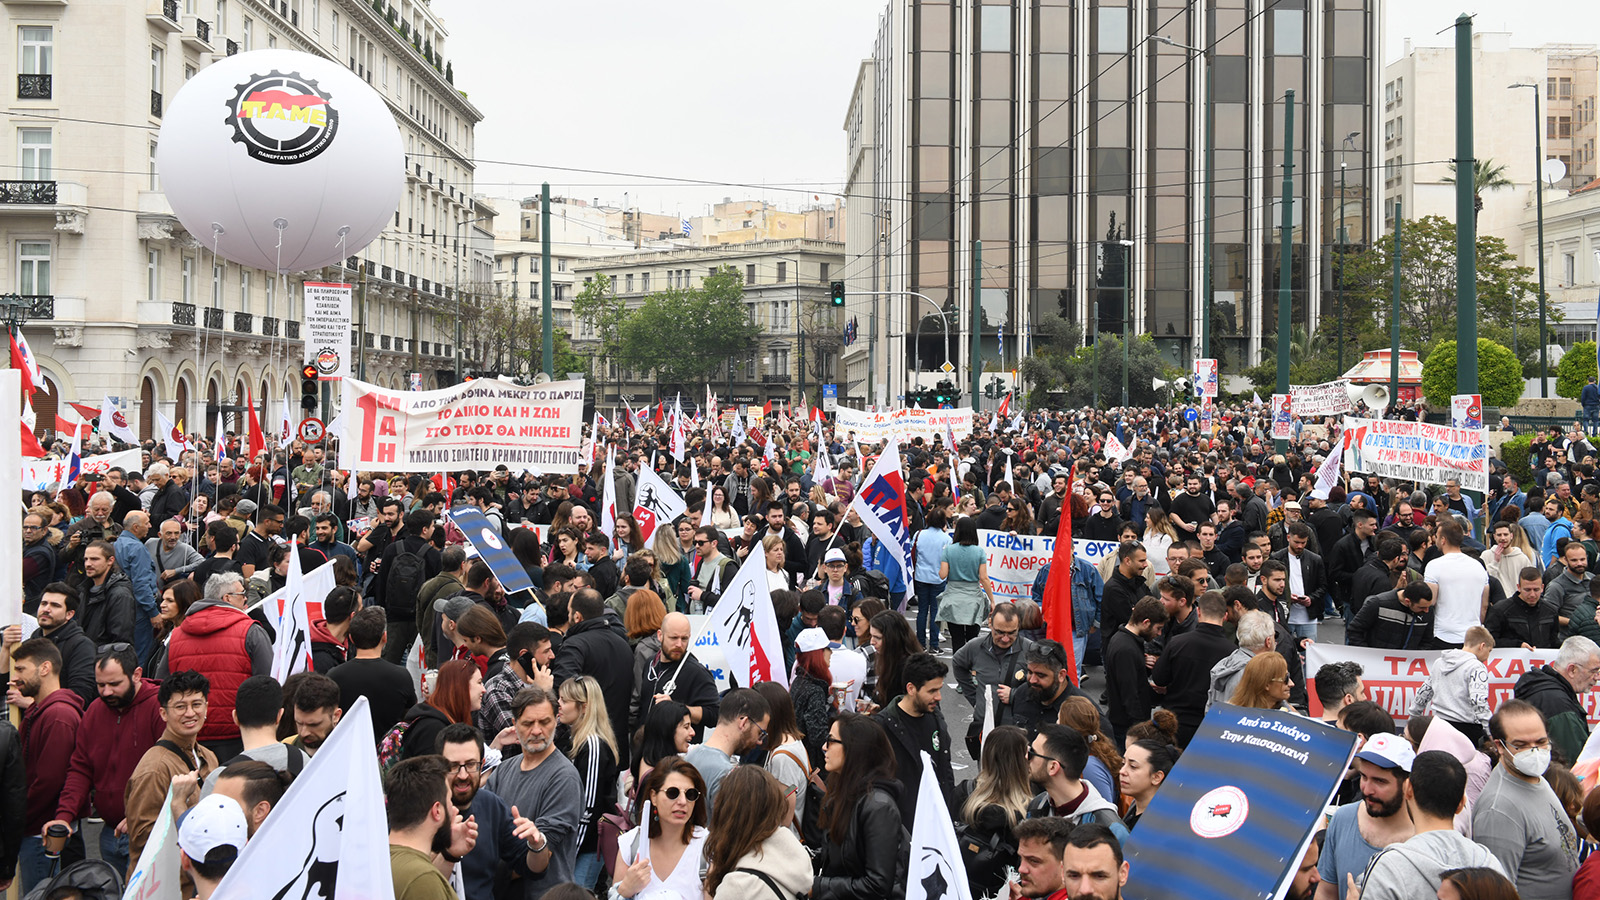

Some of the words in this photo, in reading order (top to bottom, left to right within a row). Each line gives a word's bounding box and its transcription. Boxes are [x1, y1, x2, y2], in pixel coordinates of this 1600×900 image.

[258, 150, 298, 160] ΠΑΝΕΡΓΑΤΙΚΟ
[299, 137, 327, 158] ΑΓΩΝΙΣΤΙΚΟ
[412, 400, 436, 409] ΑΠΟ
[533, 391, 547, 400] ΤΟ
[549, 391, 583, 400] ΠΑΡΙΣΙ
[437, 408, 452, 420] ΤΟ
[454, 405, 490, 418] ΔΙΚΙΟ
[493, 406, 517, 418] ΚΑΙ
[521, 406, 530, 418] Η
[533, 407, 560, 419] ΖΩΗ
[356, 391, 377, 462] 1
[425, 426, 451, 438] ΣΤΟ
[454, 424, 493, 437] ΤΕΛΟΣ
[496, 425, 515, 436] ΘΑ
[520, 425, 570, 438] ΝΙΚΗΣΕΙ
[1435, 427, 1450, 441] ΜΑΣ
[986, 533, 1033, 551] ΚΕΡΔΗ
[1383, 656, 1430, 676] ΤΑ
[1237, 716, 1260, 728] Από
[1259, 721, 1271, 729] το
[1271, 720, 1311, 742] Σικάγο
[1220, 730, 1245, 743] Στην
[1243, 734, 1309, 765] Καισαριανή
